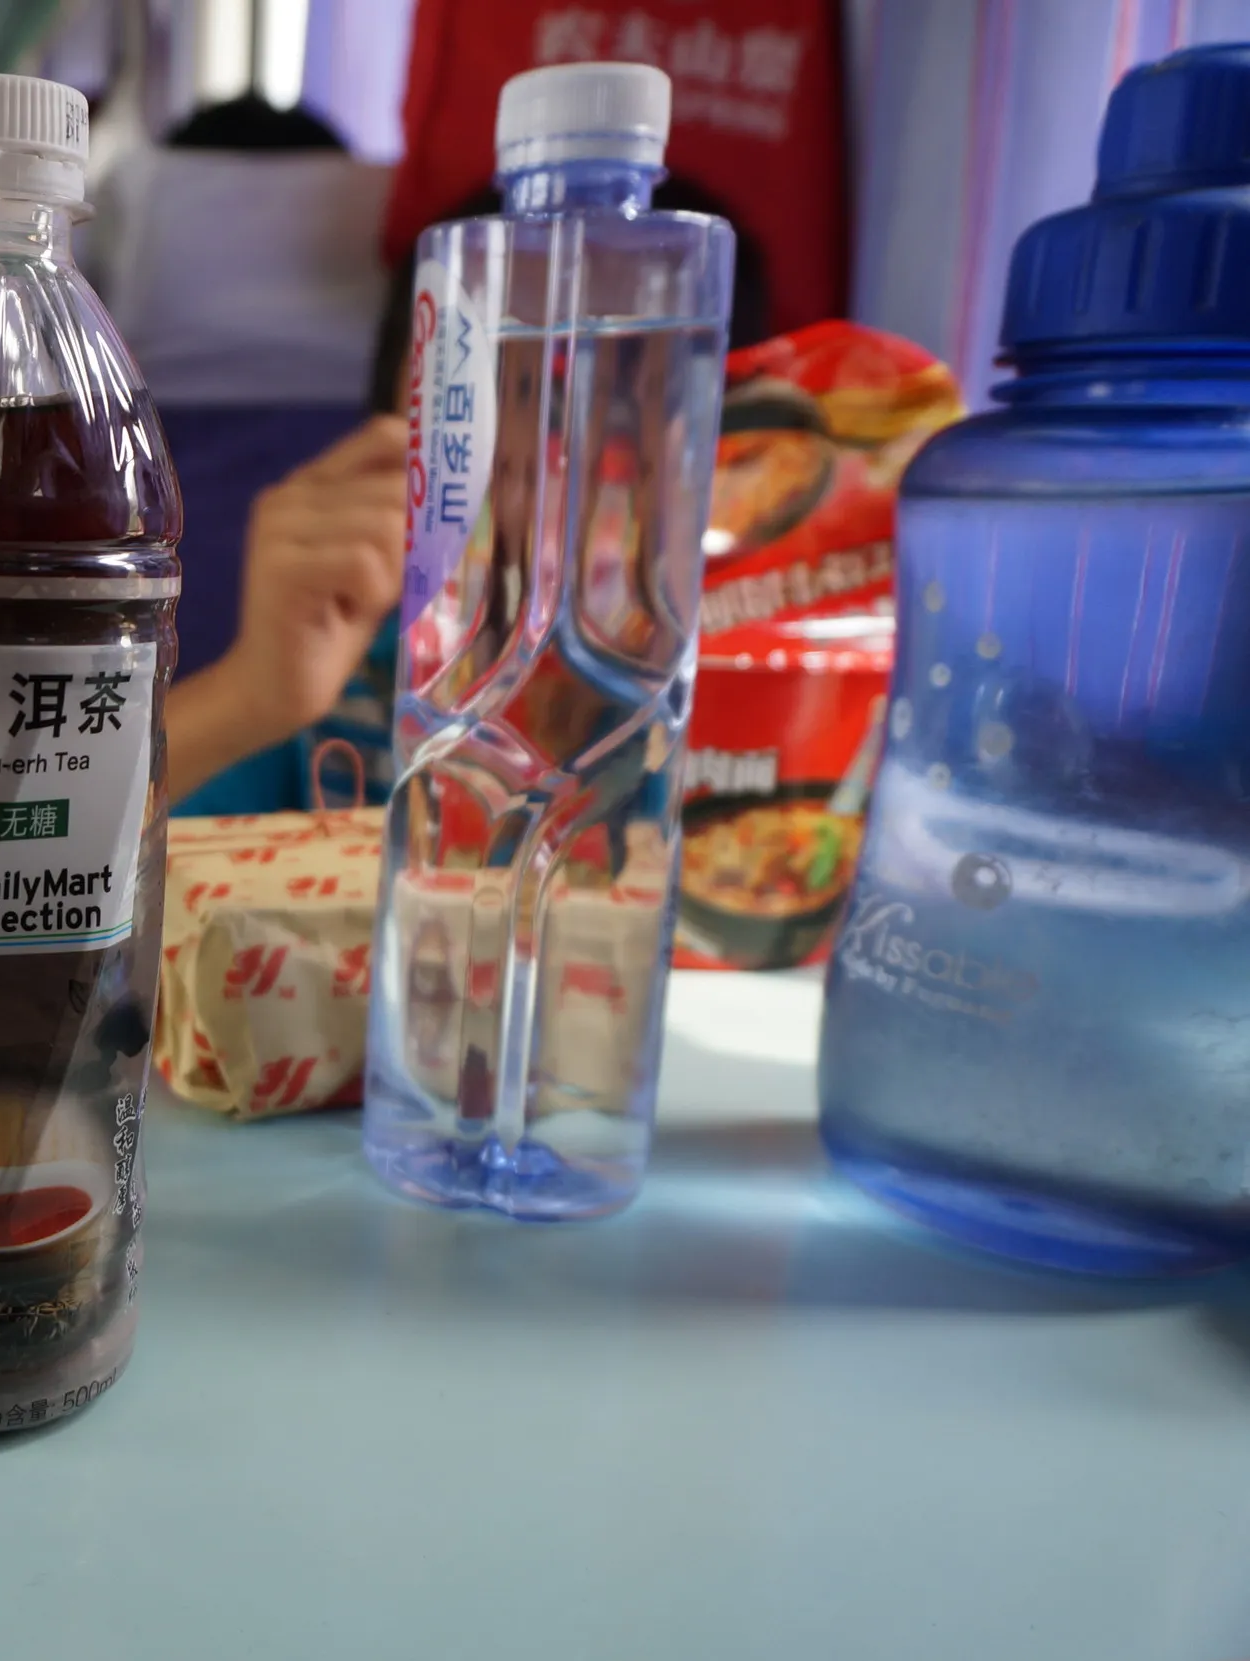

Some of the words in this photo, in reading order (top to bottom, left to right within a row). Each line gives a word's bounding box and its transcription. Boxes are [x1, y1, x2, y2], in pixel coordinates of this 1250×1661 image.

[440, 382, 474, 522] 百岁山
[54, 751, 91, 772] Tea
[0, 805, 58, 838] 无糖
